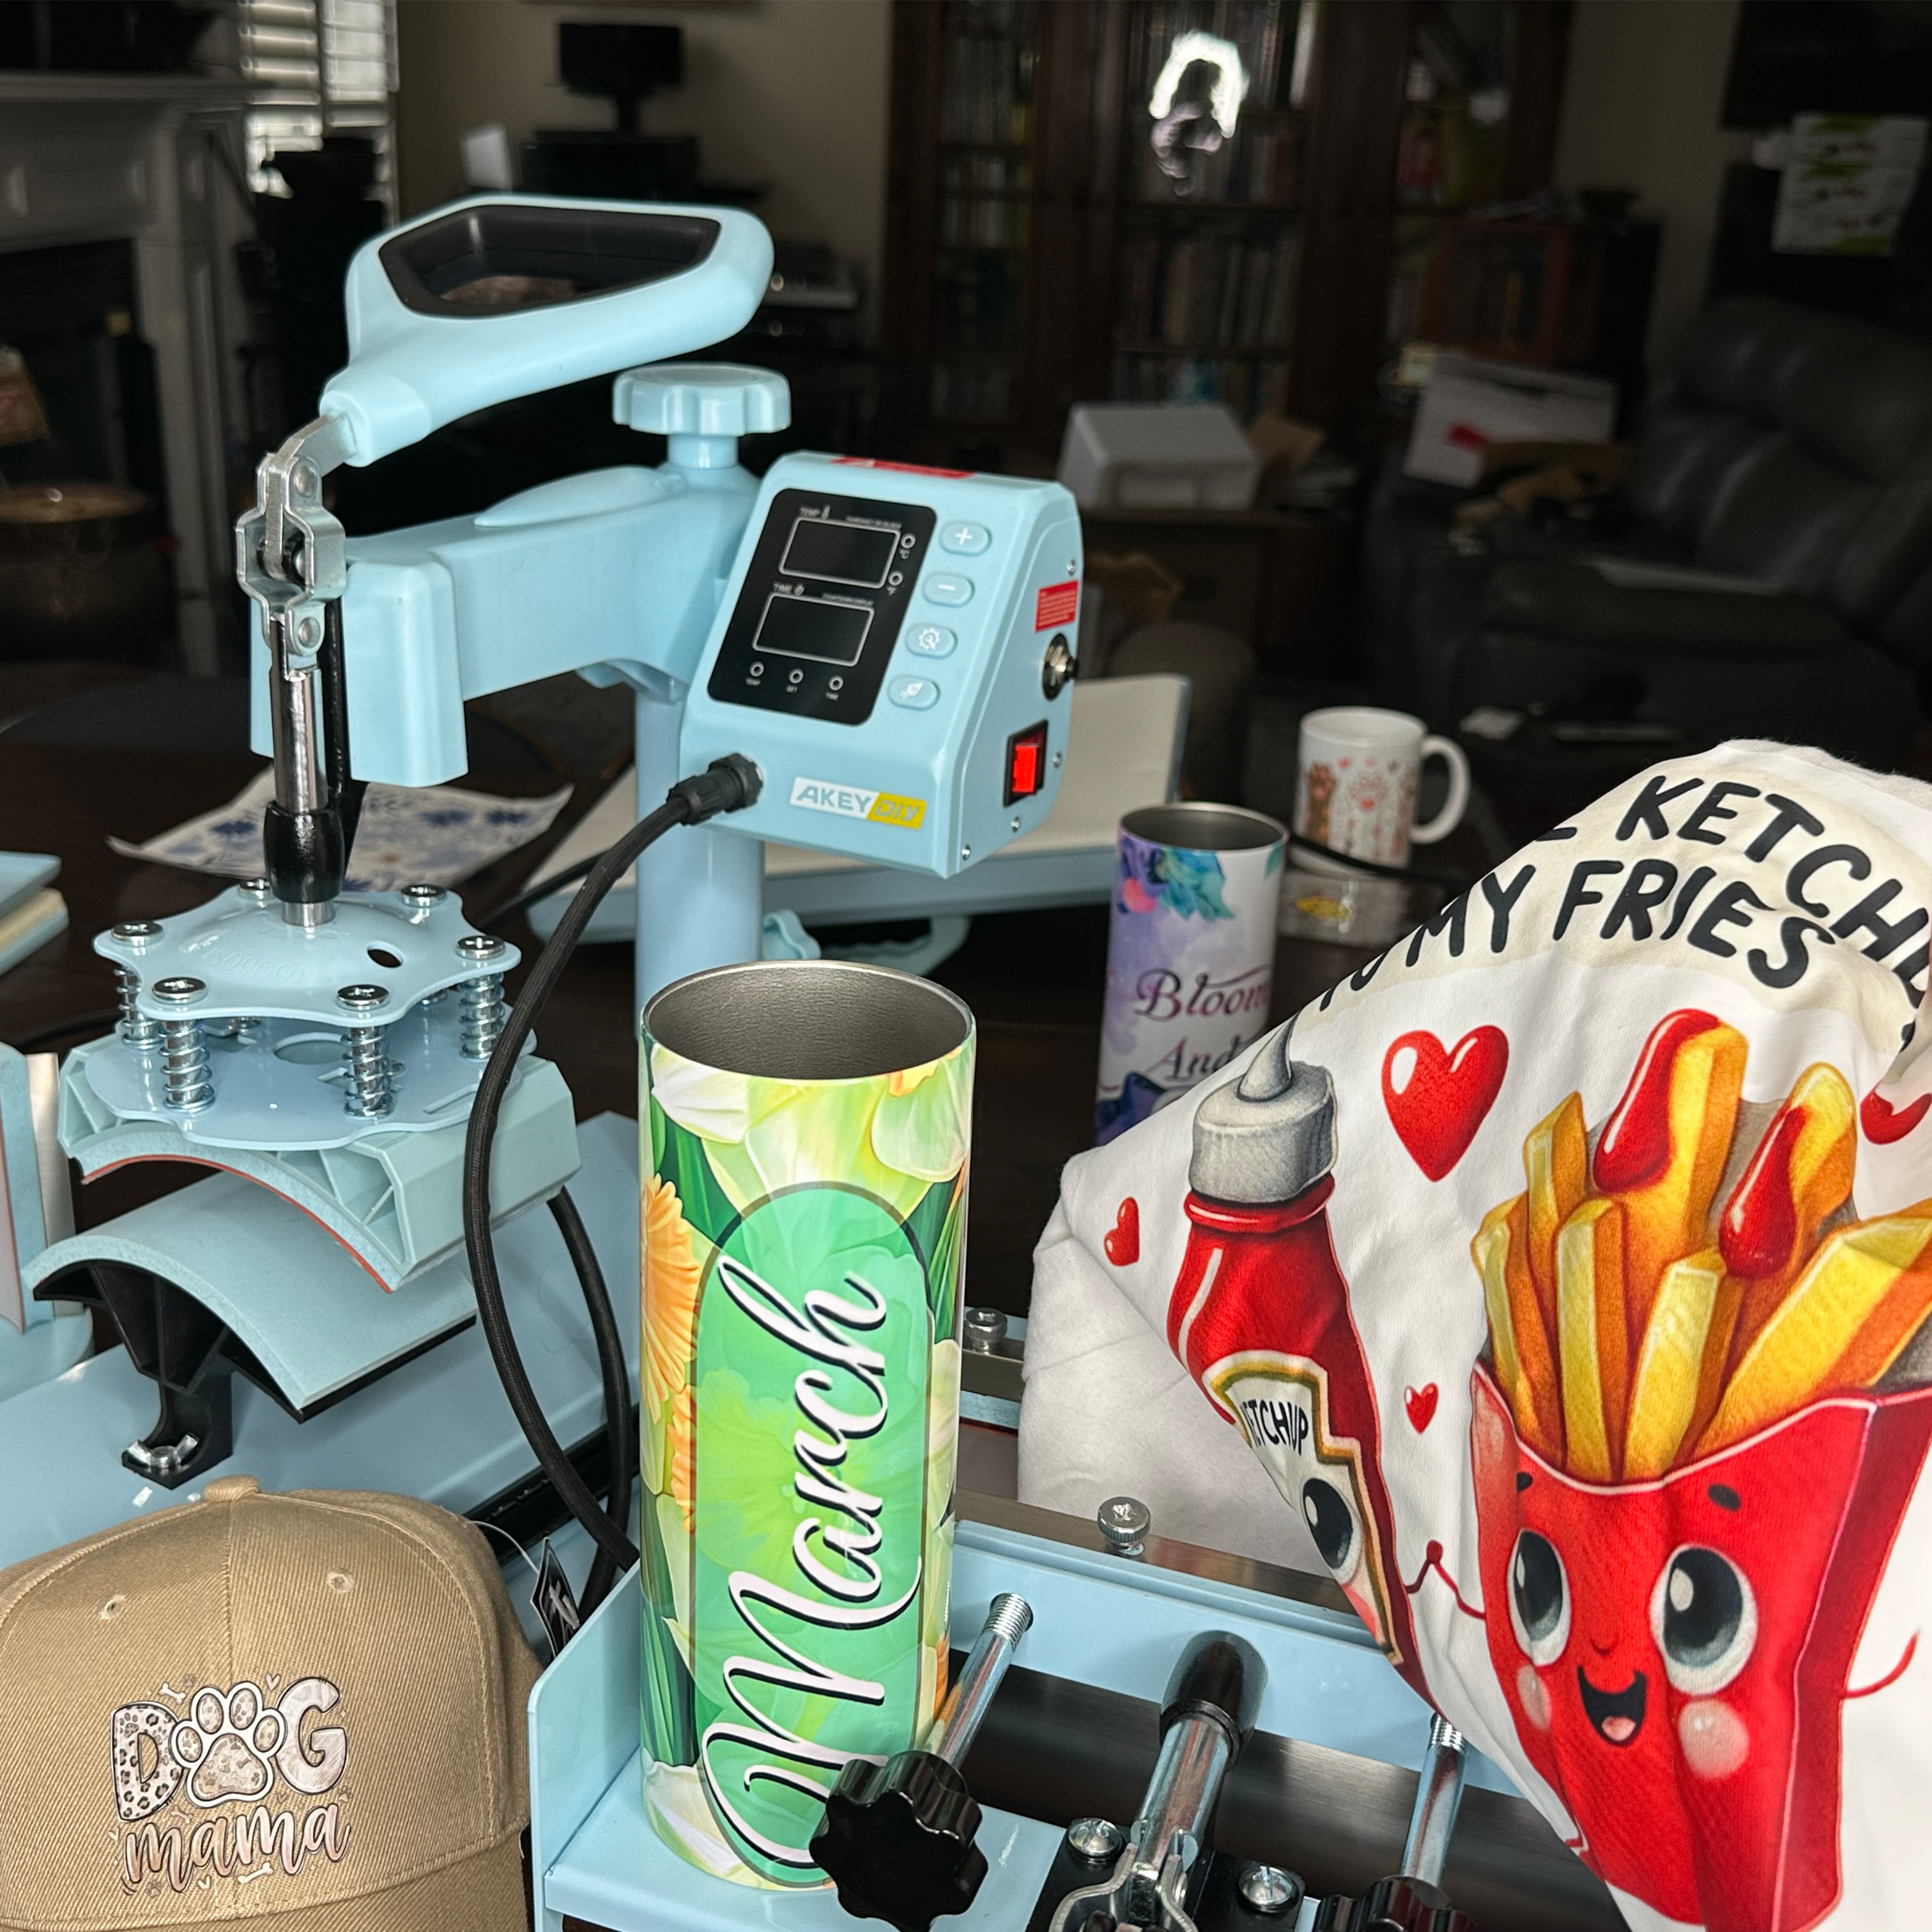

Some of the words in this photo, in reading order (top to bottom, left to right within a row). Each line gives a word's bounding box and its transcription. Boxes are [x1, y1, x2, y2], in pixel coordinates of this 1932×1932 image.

[1553, 858, 1836, 990] FRIES
[702, 1254, 923, 1868] March
[125, 1802, 351, 1894] mama
